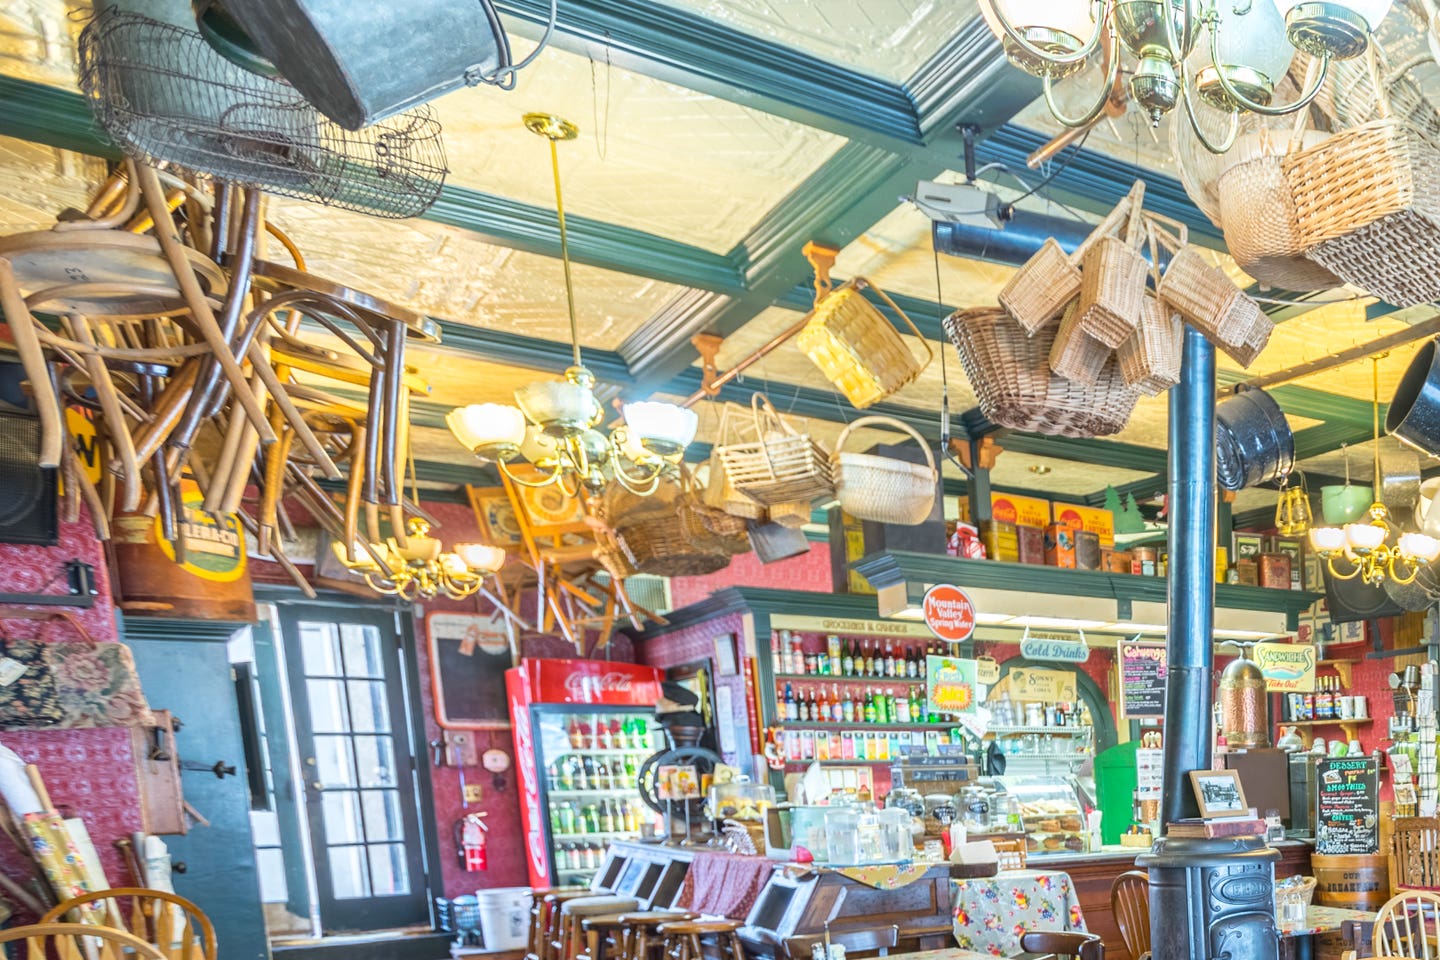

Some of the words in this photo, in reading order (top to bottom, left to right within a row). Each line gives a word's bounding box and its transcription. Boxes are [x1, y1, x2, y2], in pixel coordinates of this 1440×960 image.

[936, 608, 963, 619] Valley
[1025, 643, 1049, 657] Cold
[1052, 645, 1087, 660] Drinks
[1329, 761, 1368, 770] DESSERT
